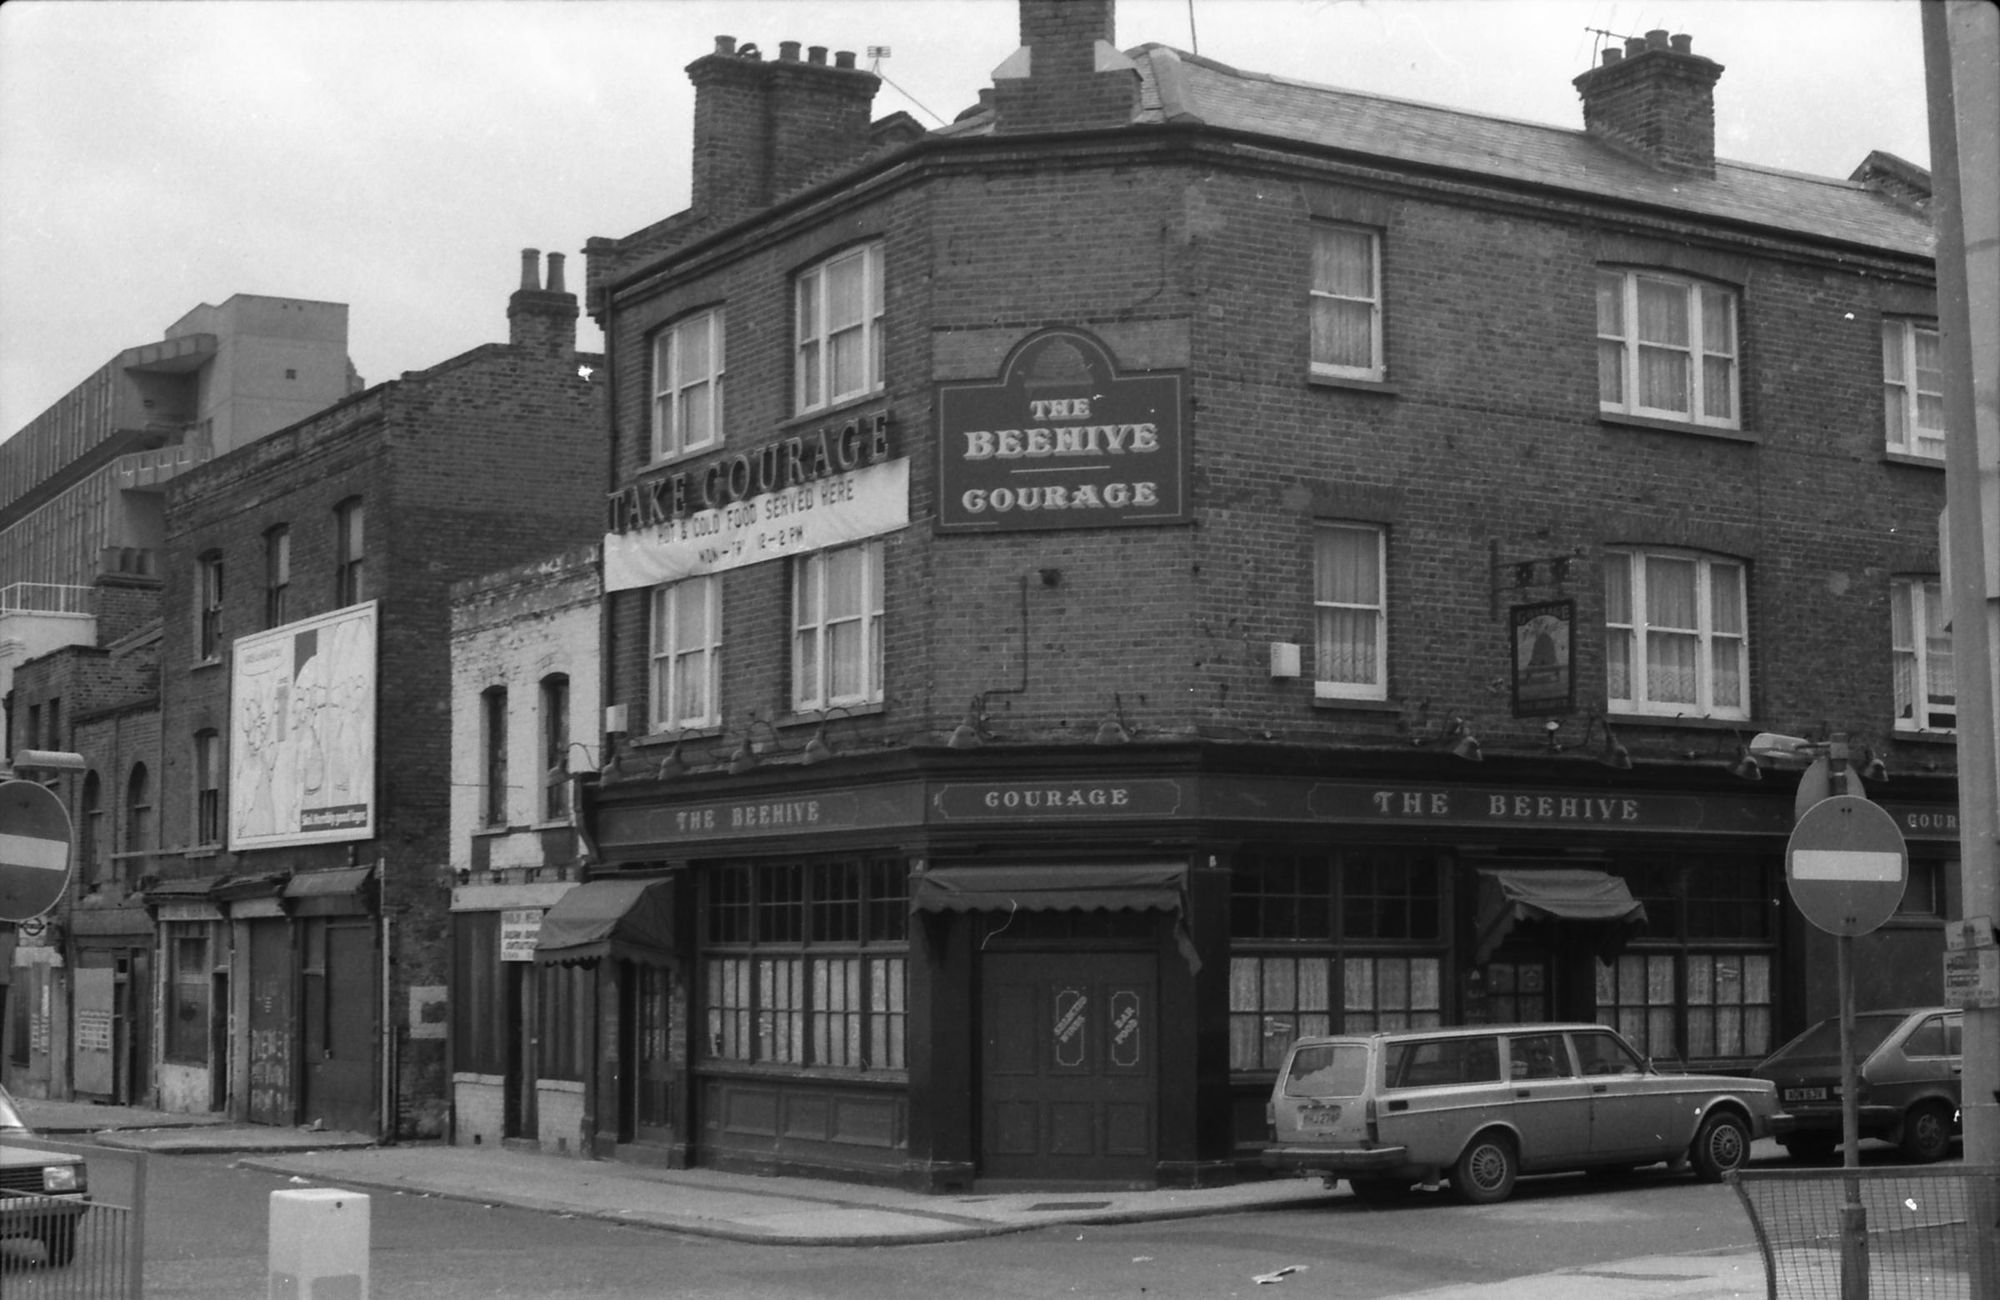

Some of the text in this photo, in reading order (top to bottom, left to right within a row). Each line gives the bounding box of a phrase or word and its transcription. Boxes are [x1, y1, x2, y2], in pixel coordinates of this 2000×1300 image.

[1030, 398, 1092, 421] THE
[963, 422, 1160, 460] BEEHIVE
[607, 409, 889, 534] TAKE COURAGE
[727, 503, 757, 530] FOOD
[765, 487, 814, 520] SERVED
[821, 479, 854, 505] HERE
[962, 482, 1159, 513] COURAGE
[985, 788, 1129, 807] COURAGE
[1373, 791, 1639, 820] THE BEEHIVE
[676, 800, 820, 831] THE BEEHIVE
[1907, 813, 1957, 828] COUR
